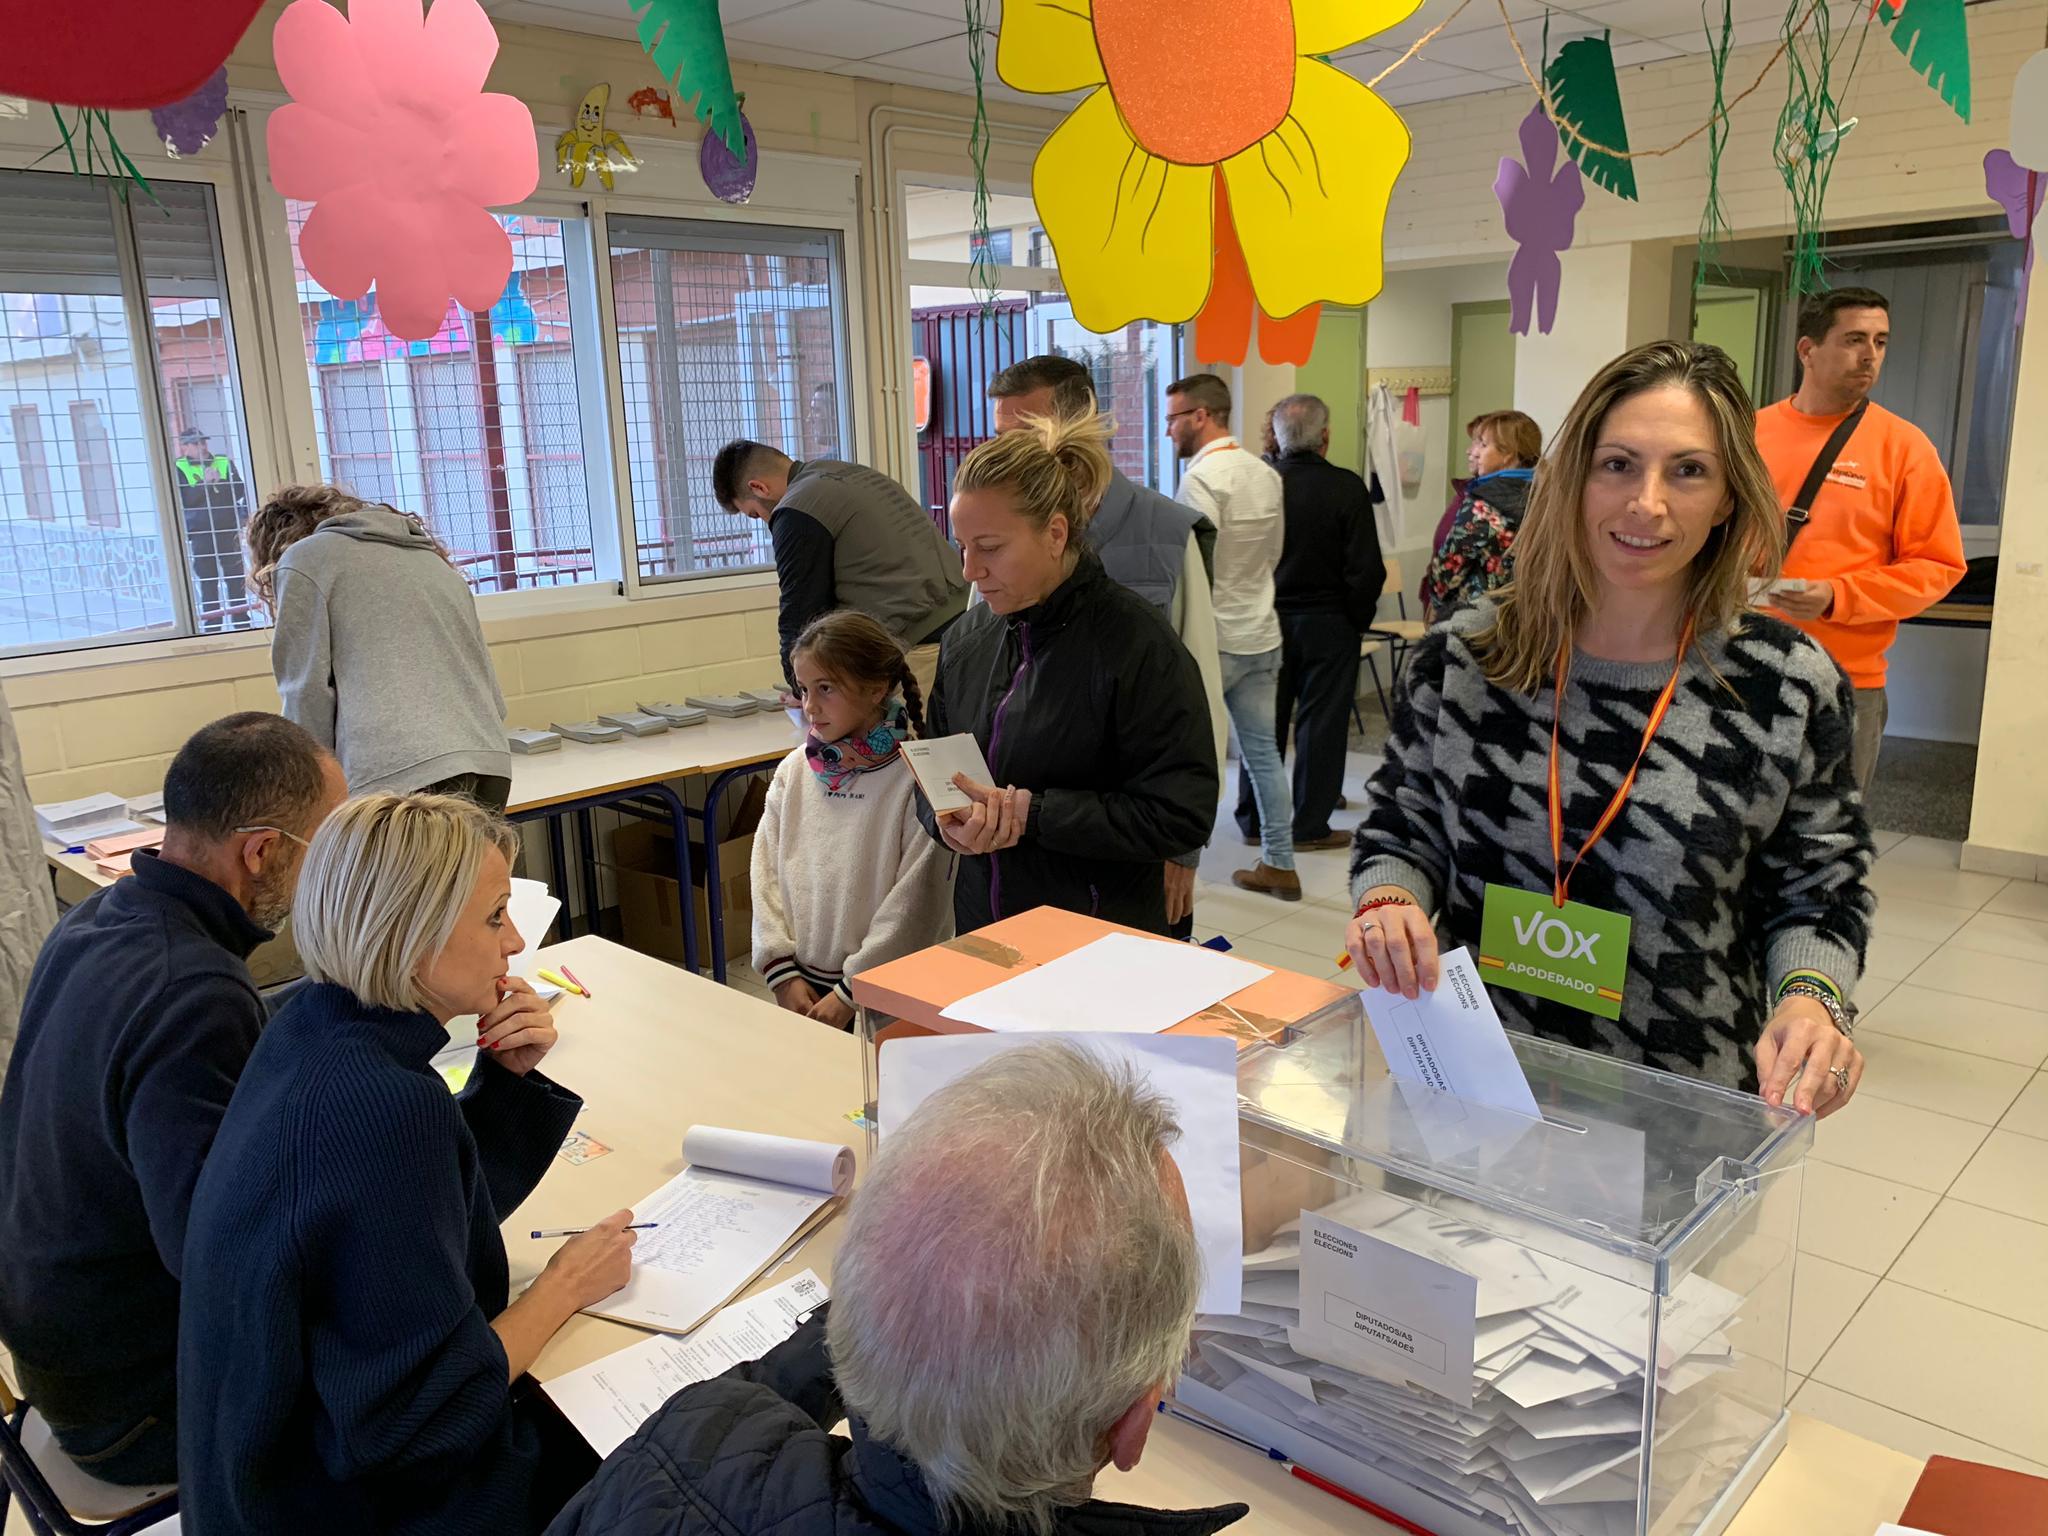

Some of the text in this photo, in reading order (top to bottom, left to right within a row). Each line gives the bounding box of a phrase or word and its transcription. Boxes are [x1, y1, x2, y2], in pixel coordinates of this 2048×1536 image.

[1513, 911, 1600, 965] VOX
[1447, 969, 1469, 1009] ELECCIONS
[1455, 965, 1480, 1010] ELECCIONES
[1507, 962, 1595, 993] APODERADO
[1406, 1036, 1435, 1088] DIPUTATS/AD
[1416, 1033, 1447, 1091] DIPUTADOS/AS
[1313, 1238, 1354, 1259] ELECCIONS
[1314, 1229, 1358, 1252] ELECCIONES
[1354, 1321, 1415, 1354] DIPUTATS/ADES
[1355, 1311, 1413, 1342] DIPUTADOS/AS
